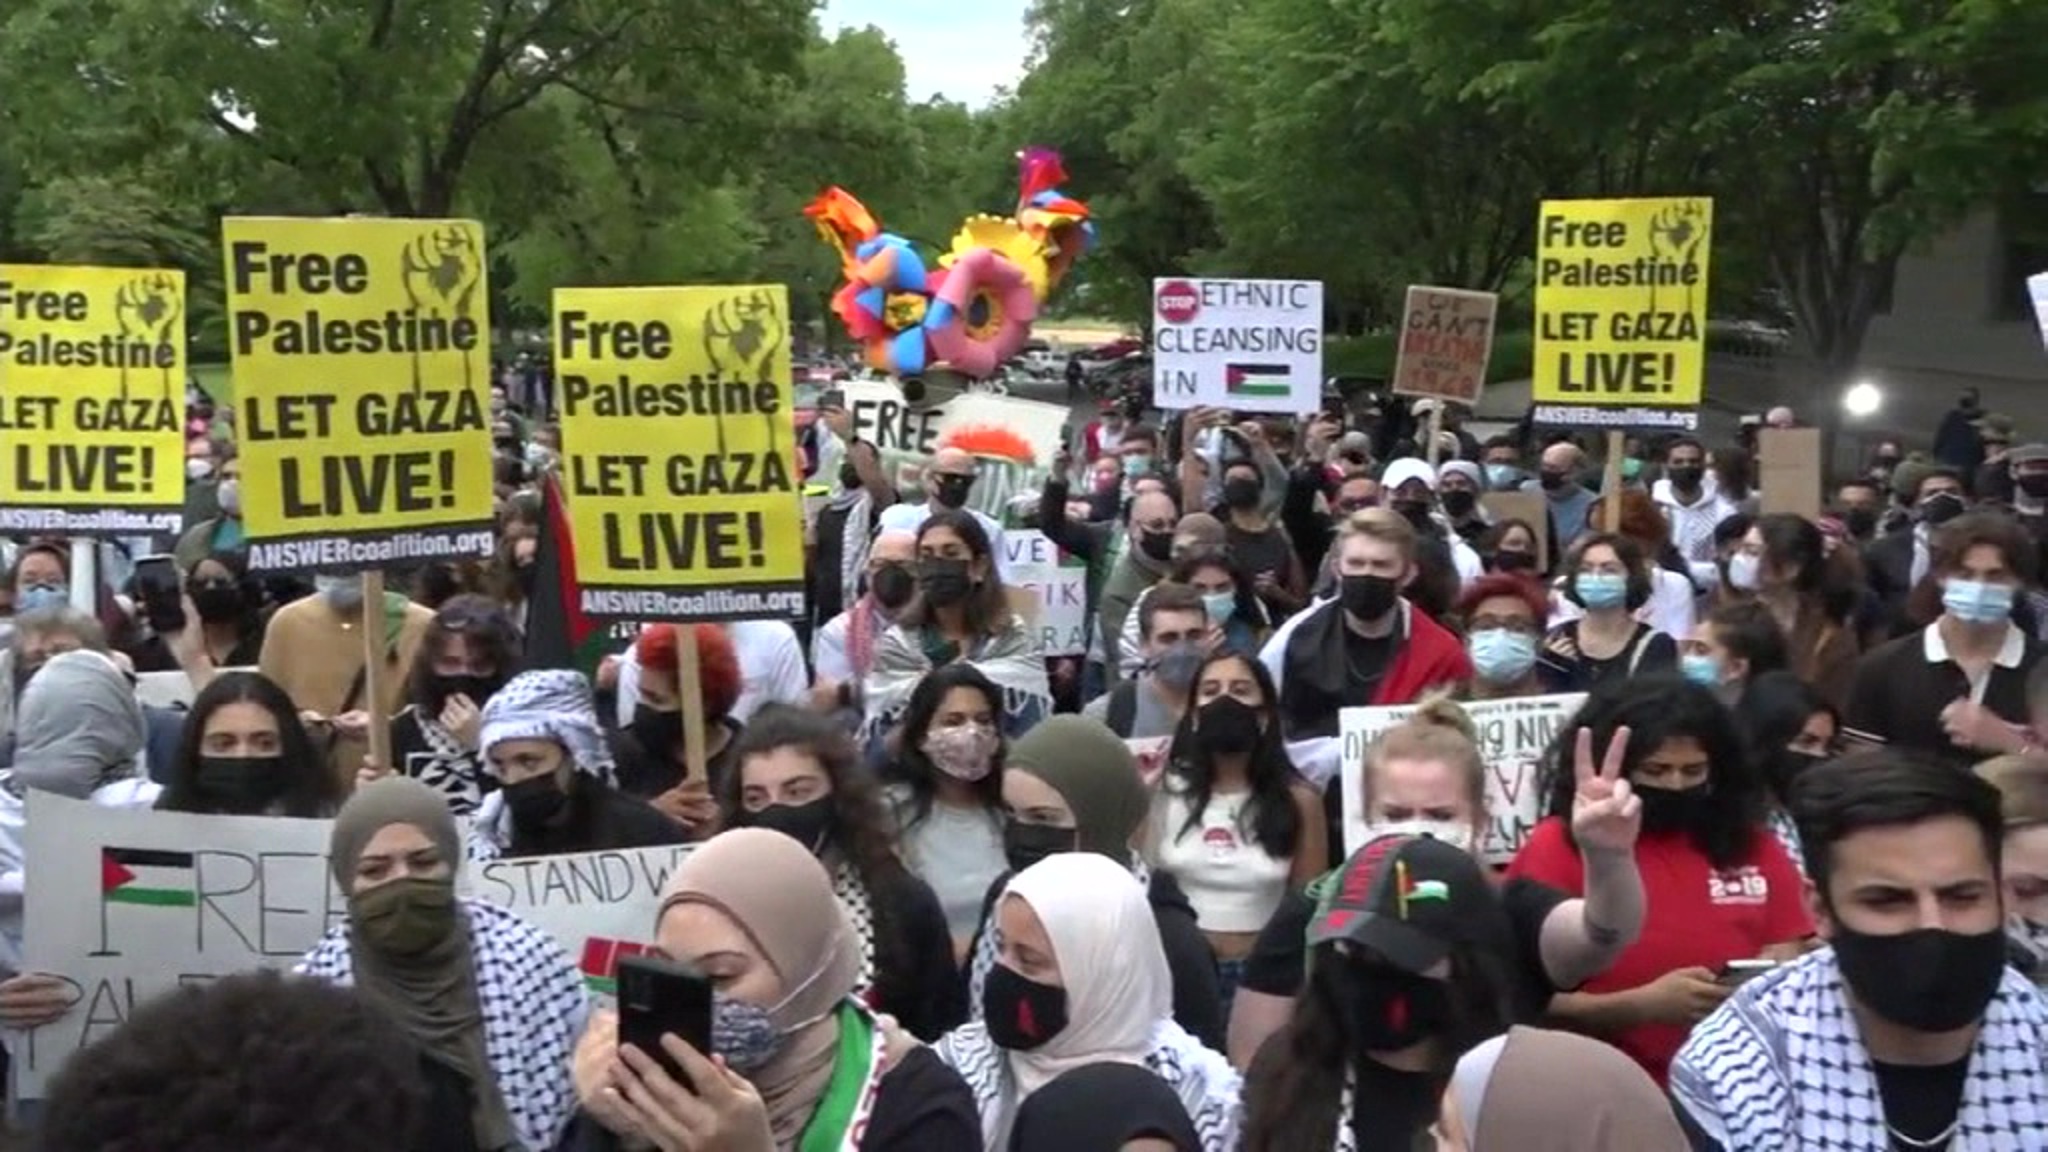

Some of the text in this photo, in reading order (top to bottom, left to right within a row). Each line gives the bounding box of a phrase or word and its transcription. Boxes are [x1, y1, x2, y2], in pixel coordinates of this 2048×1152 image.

[1544, 215, 1627, 248] Free
[232, 241, 368, 295] Free
[1541, 256, 1698, 287] Palestine
[1201, 282, 1308, 308] ETHNIC
[236, 309, 479, 355] Palestine
[559, 311, 672, 360] Free
[1156, 326, 1317, 354] CLEANSING
[1541, 312, 1698, 341] LET GAZA
[1162, 369, 1197, 395] IN
[1558, 352, 1675, 393] LIVE!
[0, 396, 179, 432] LET GAZA
[245, 389, 485, 440] LET GAZA
[563, 372, 779, 417] Palestine
[852, 400, 944, 454] FREE
[15, 444, 154, 492] LIVE!
[280, 450, 456, 518] LIVE!
[572, 452, 790, 497] LET GAZA
[0, 508, 182, 534] NSWERcoalition.org
[603, 511, 766, 570] LIVE!
[248, 532, 495, 570] ANSWERcoalition.org
[1006, 537, 1047, 563] VE
[581, 588, 805, 615] ANSWERcoalition.org
[482, 851, 634, 908] STAND
